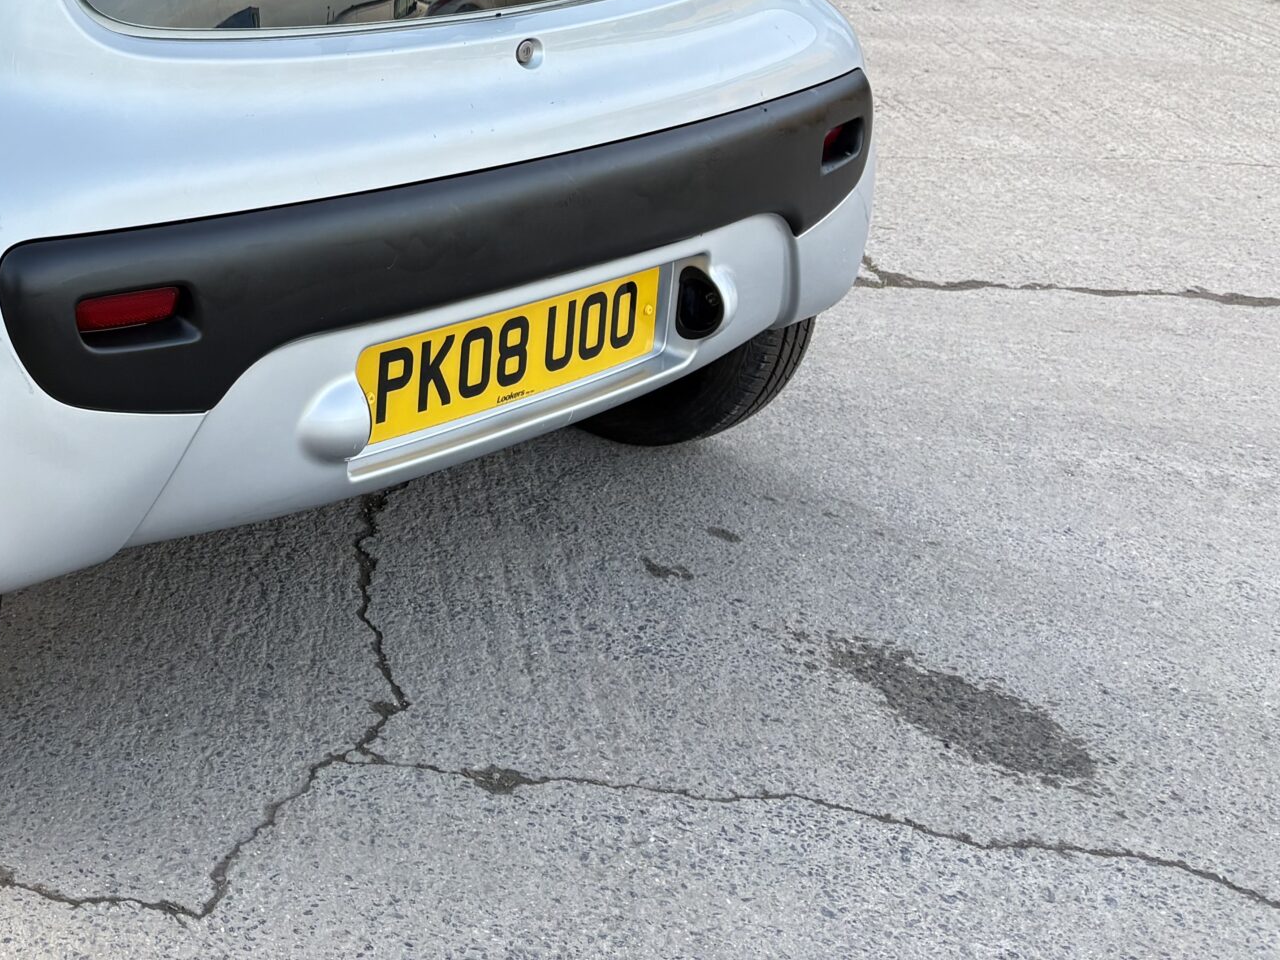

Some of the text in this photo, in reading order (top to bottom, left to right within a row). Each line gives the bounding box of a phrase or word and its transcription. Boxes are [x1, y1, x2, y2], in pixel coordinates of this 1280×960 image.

[375, 280, 638, 425] PK08 UOO
[497, 390, 525, 403] Lookers
